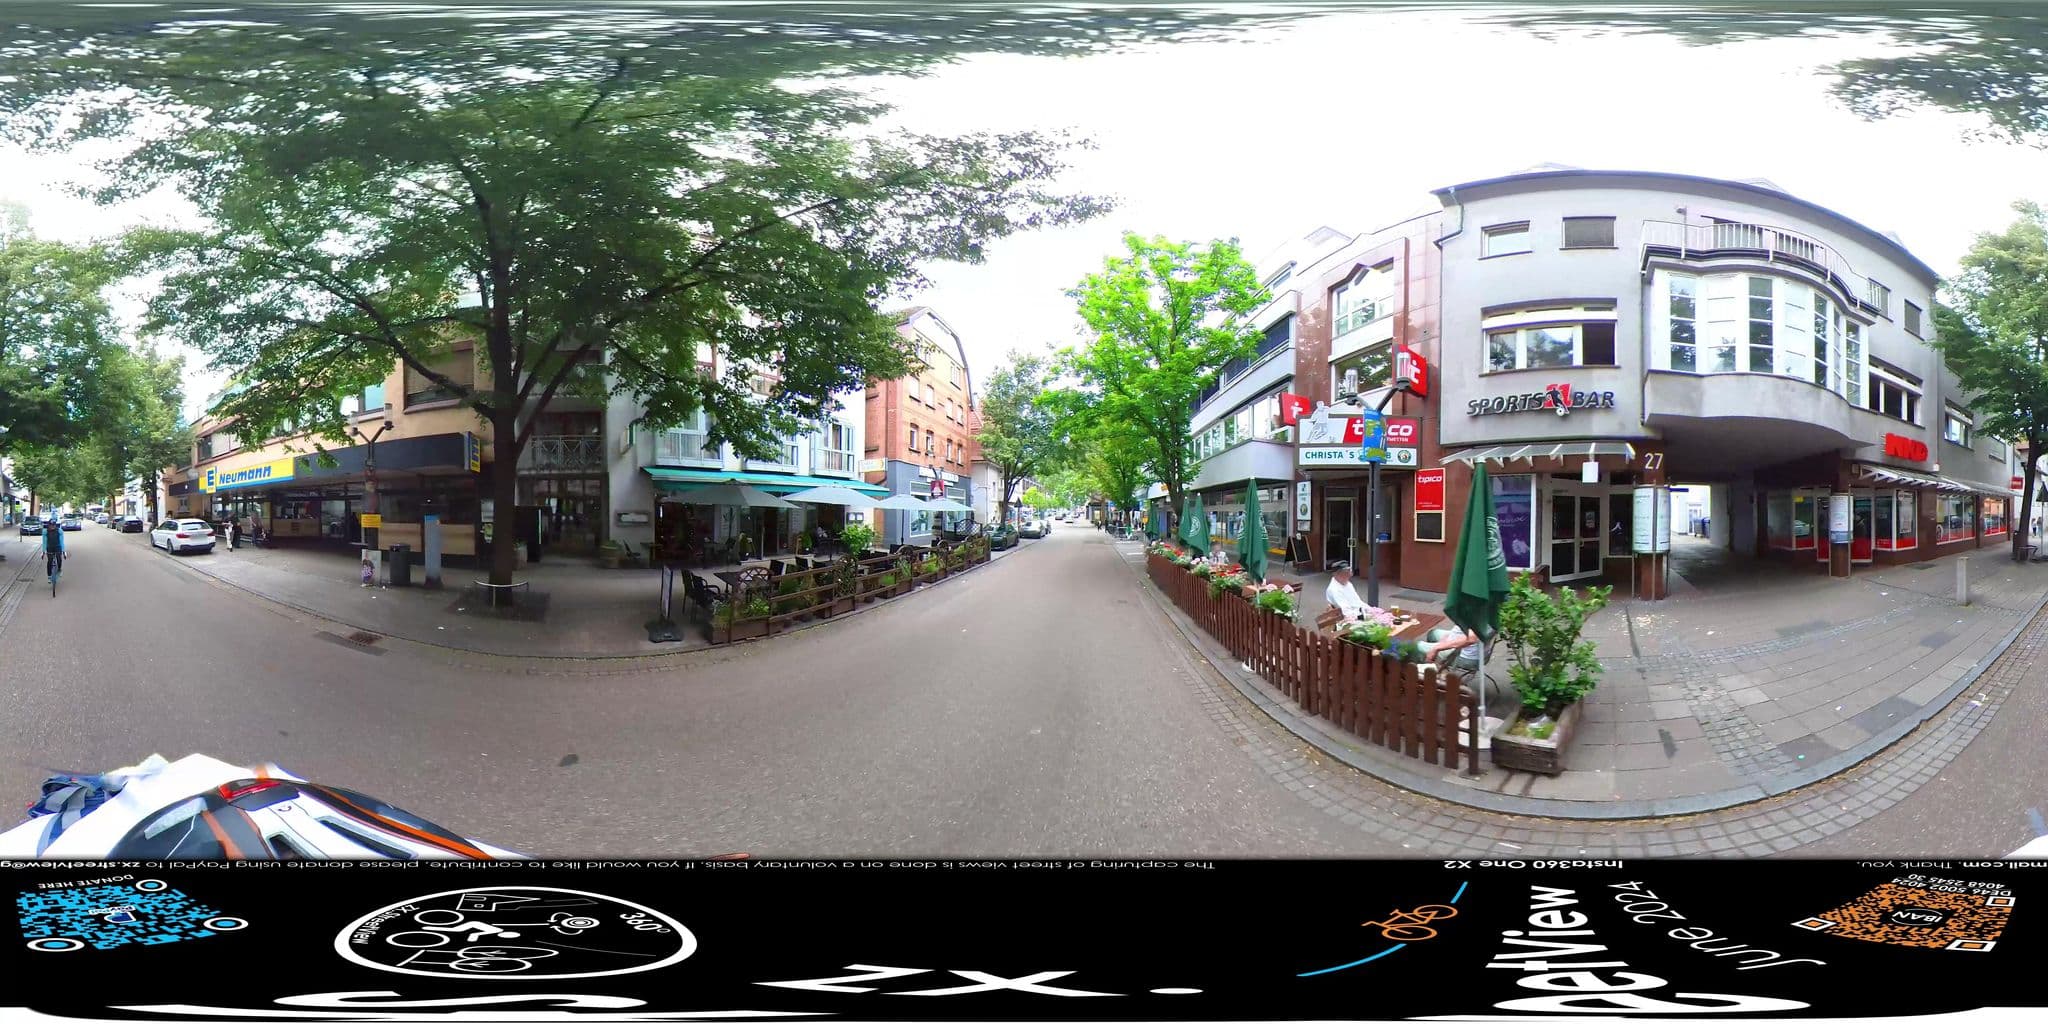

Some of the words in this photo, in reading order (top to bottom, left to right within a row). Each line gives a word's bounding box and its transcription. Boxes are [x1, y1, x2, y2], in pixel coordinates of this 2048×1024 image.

[1467, 392, 1546, 416] SPORTS
[1573, 391, 1615, 408] BAR
[1644, 452, 1664, 470] 27
[219, 466, 272, 485] Neumann
[1417, 474, 1443, 484] tipico
